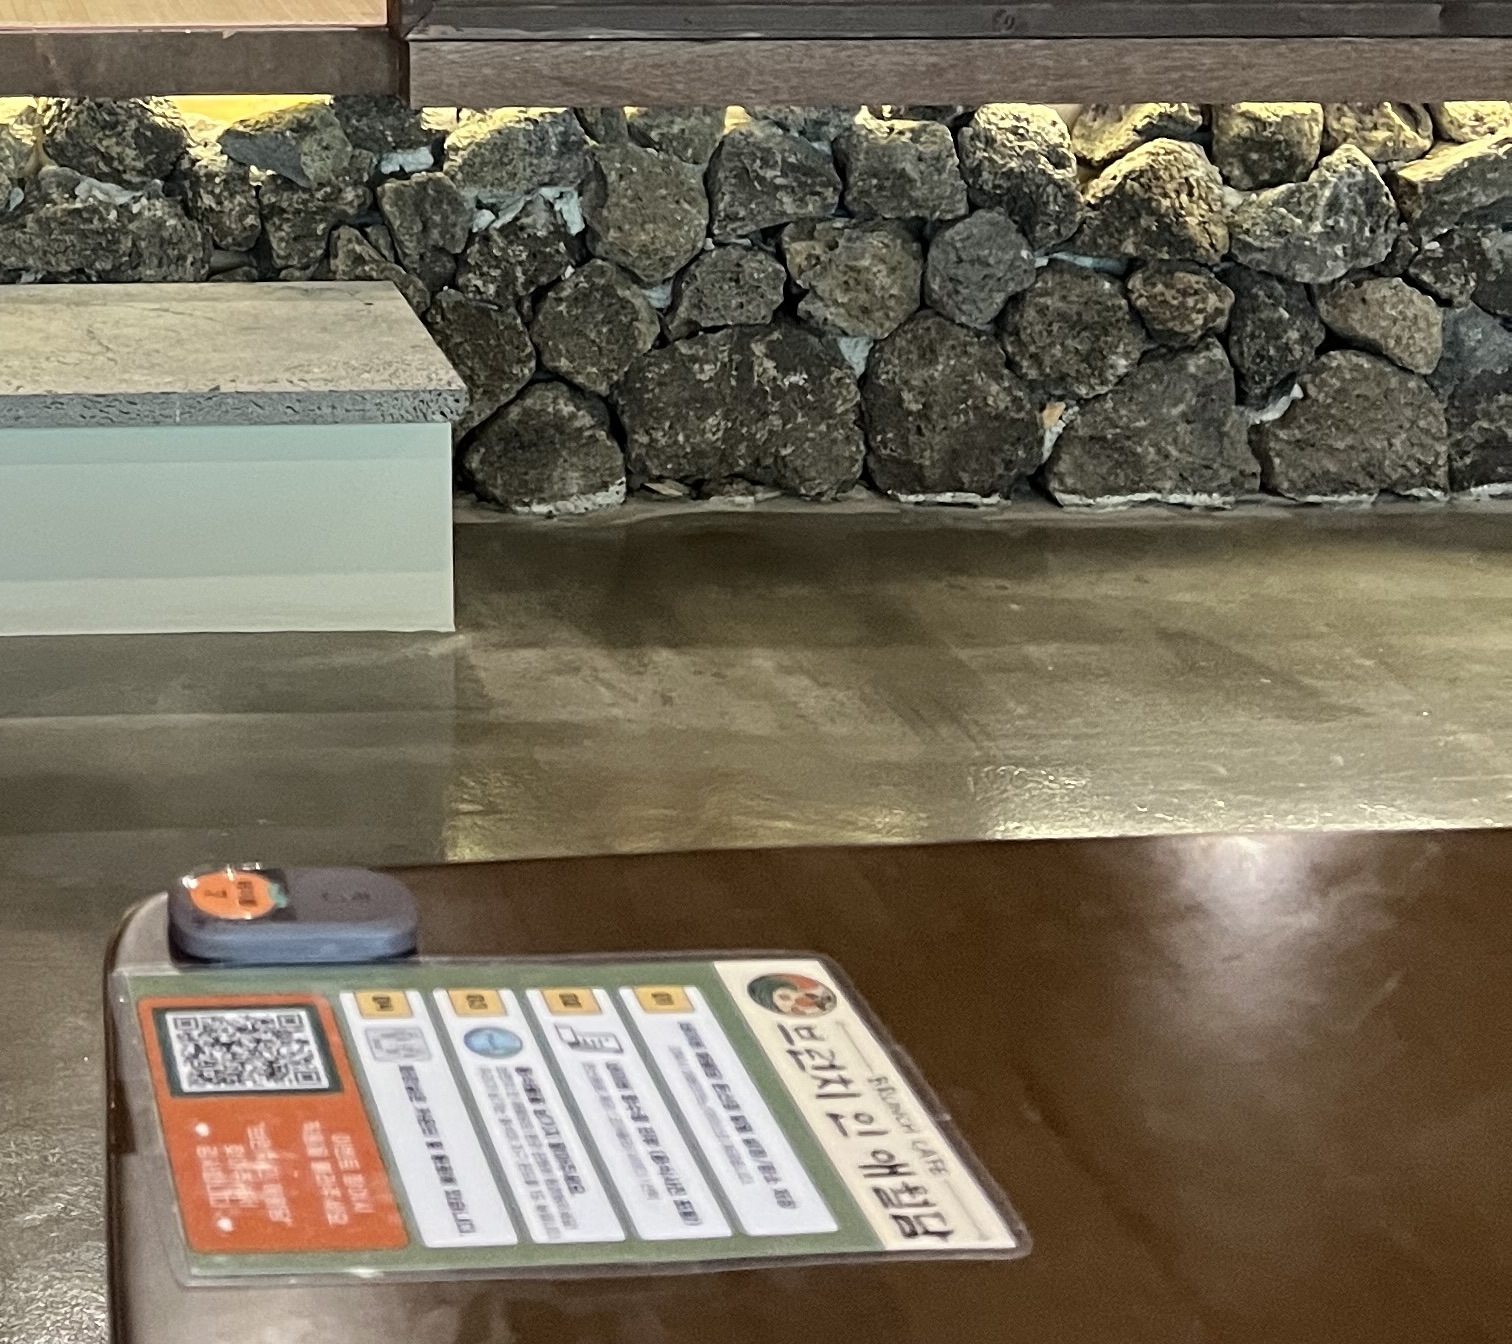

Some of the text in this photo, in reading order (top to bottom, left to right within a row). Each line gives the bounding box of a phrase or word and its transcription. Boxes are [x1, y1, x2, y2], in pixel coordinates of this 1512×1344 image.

[777, 1022, 954, 1242] 브런치 인 애월담
